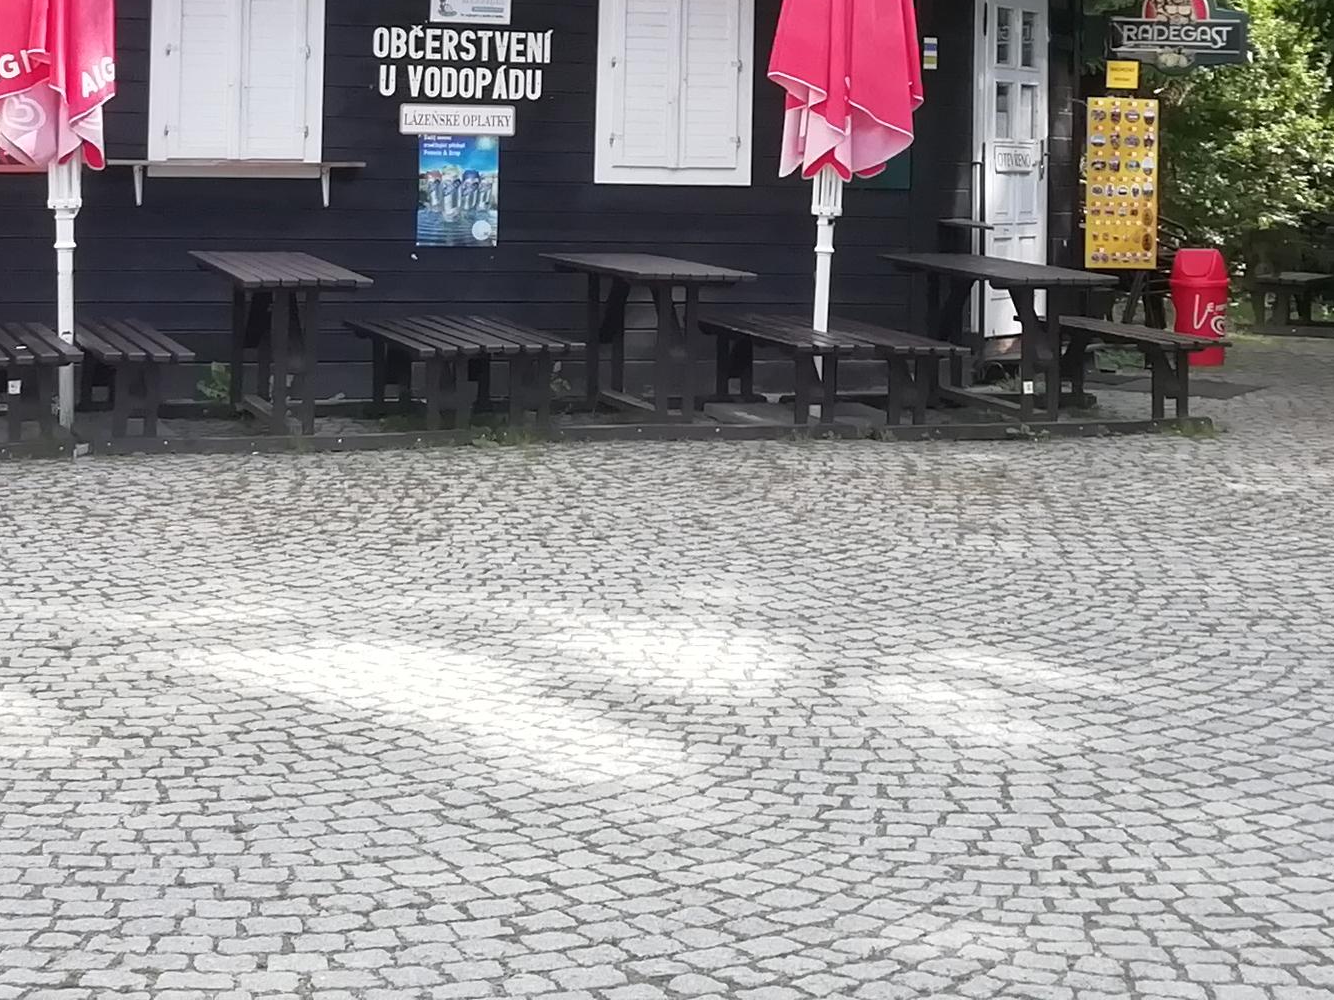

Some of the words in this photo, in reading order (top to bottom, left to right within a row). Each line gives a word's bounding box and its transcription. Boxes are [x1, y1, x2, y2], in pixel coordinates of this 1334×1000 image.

[373, 25, 554, 64] OBČERSTVENÍ
[1122, 25, 1233, 48] RADEGAST
[379, 64, 397, 97] U
[407, 65, 543, 100] VODOPÁDU
[404, 109, 460, 126] LÁZEŇSKÉ
[462, 114, 511, 128] OPLATKY
